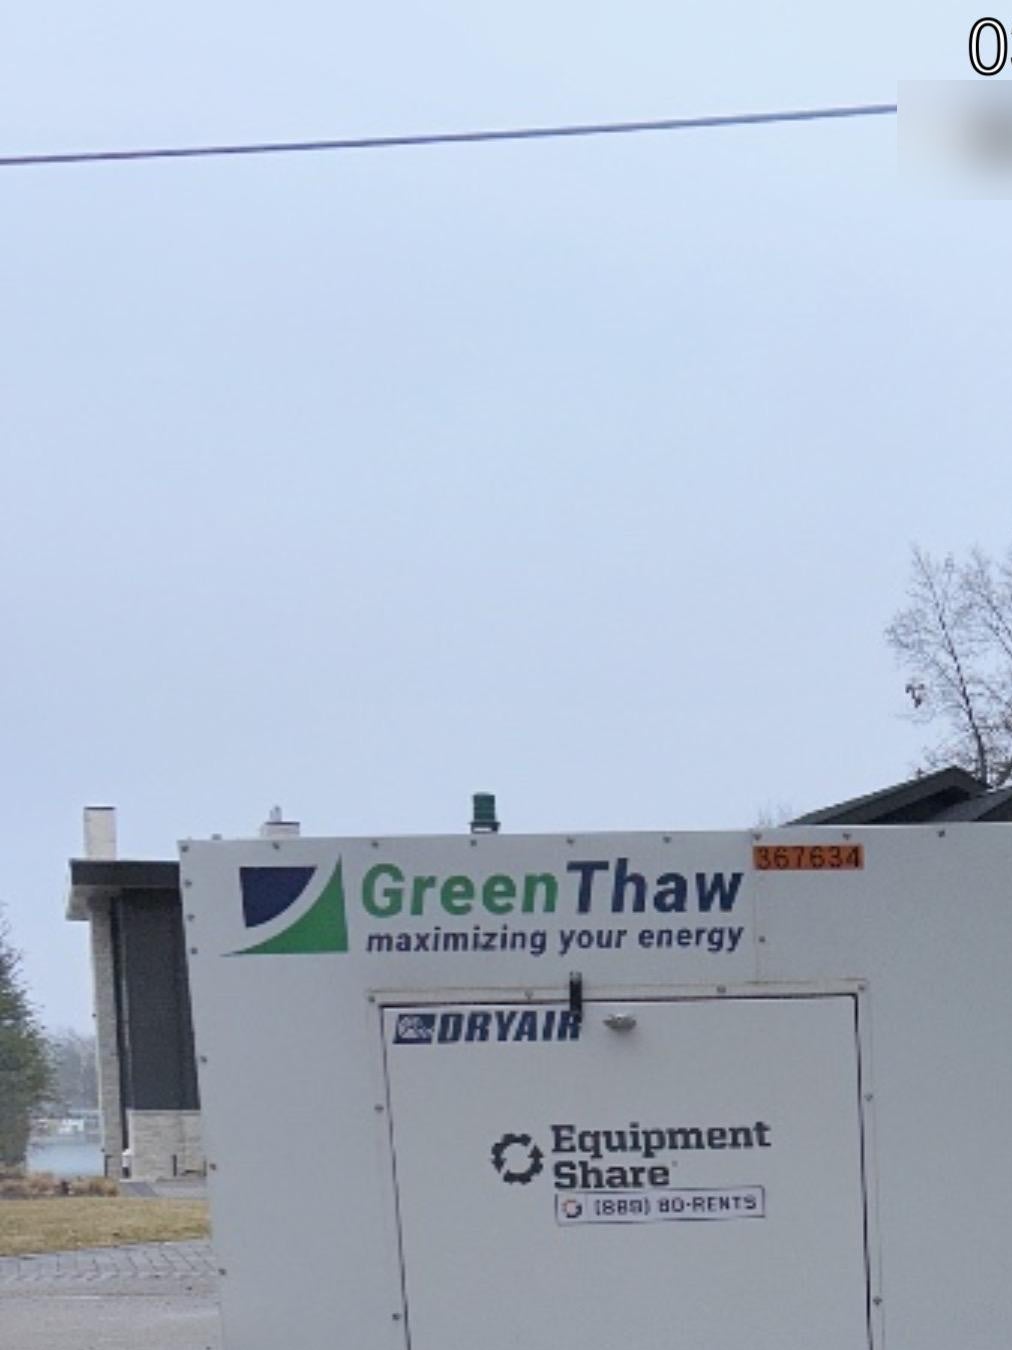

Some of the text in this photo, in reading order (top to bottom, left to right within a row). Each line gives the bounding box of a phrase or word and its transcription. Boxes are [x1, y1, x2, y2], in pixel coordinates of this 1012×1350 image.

[756, 845, 860, 870] 367634
[366, 924, 744, 955] maximizing your energy
[437, 1009, 582, 1042] DRYAIR
[551, 1122, 771, 1158] Equipment
[554, 1161, 670, 1188] Share
